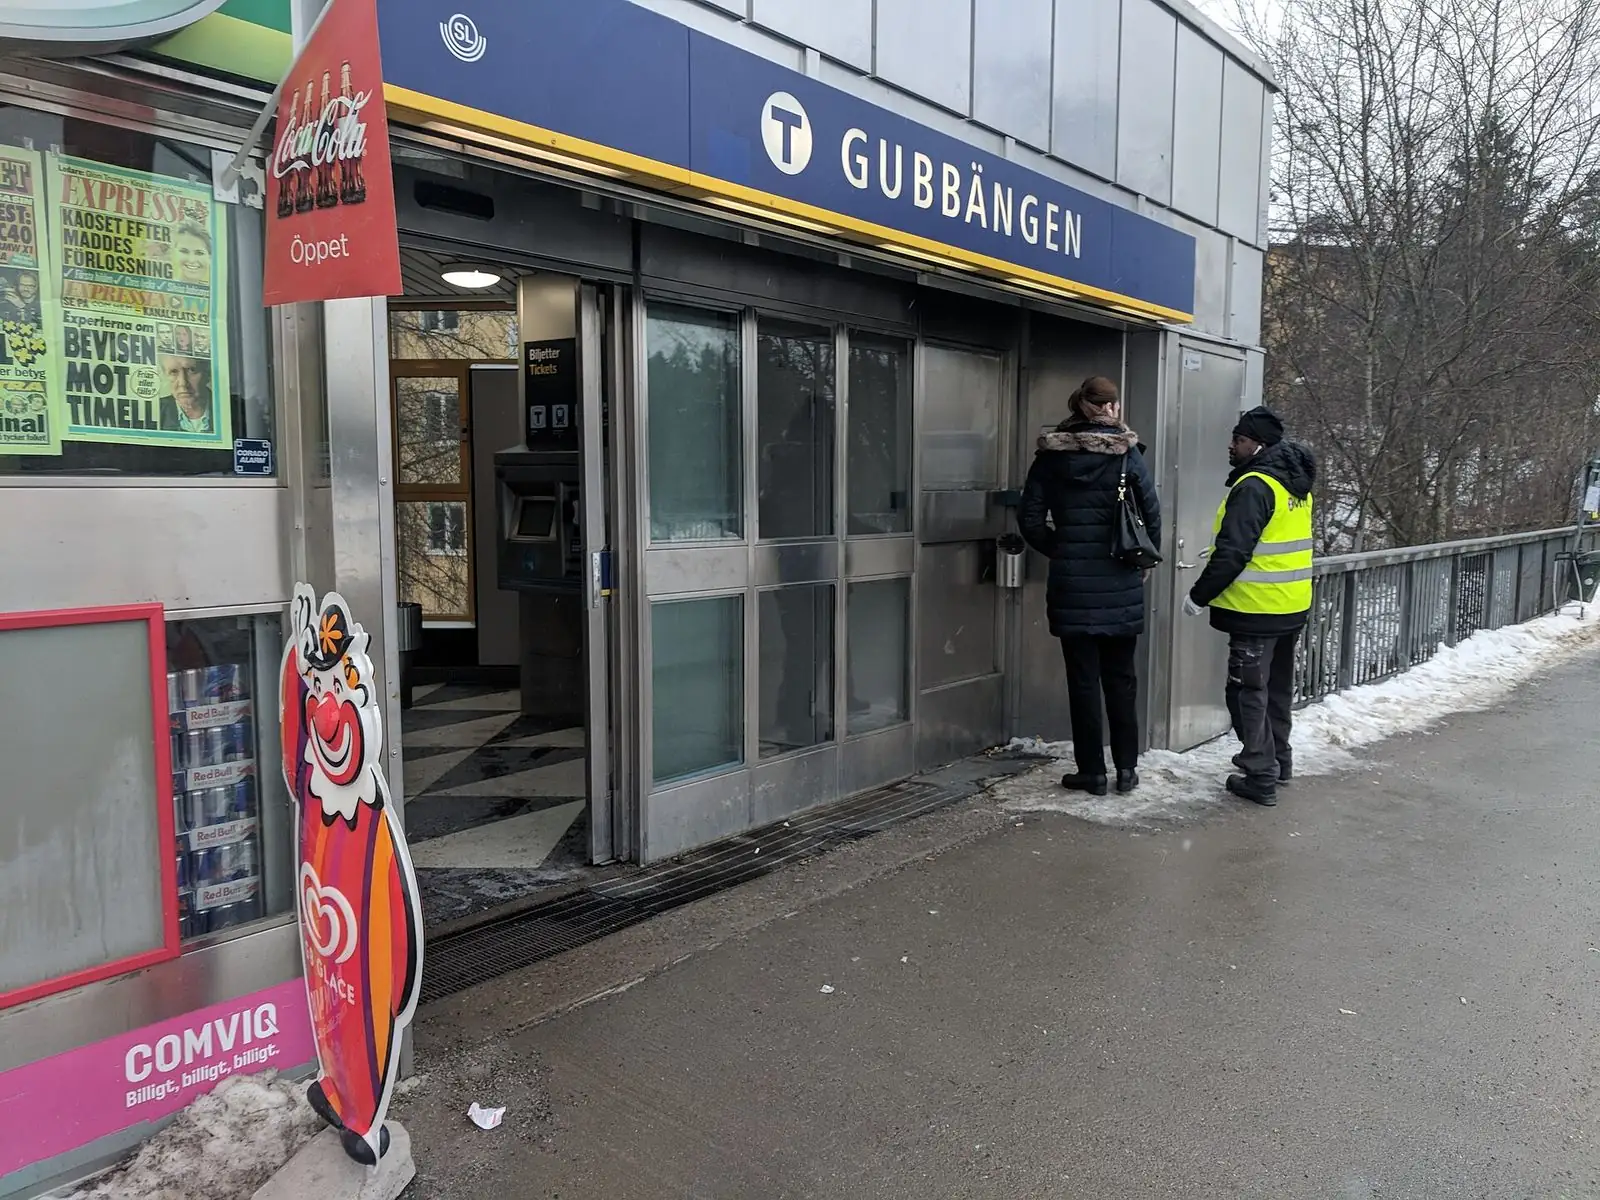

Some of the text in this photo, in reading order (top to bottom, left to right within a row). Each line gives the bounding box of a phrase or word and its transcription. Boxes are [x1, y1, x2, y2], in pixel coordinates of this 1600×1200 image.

[454, 22, 474, 45] SL
[273, 88, 373, 179] Coca-Cola
[841, 128, 1082, 259] GUBBÄNGEN
[62, 207, 171, 243] KAOSET EFTER
[63, 228, 133, 255] MADDES
[291, 233, 350, 266] Öppet
[63, 247, 173, 280] FÖRLOSSNING
[63, 310, 154, 334] Experterna om
[144, 306, 196, 323] KANALPLATS
[64, 326, 156, 366] BEVISEN
[529, 348, 560, 362] Biljetter
[15, 367, 46, 380] betyg
[66, 361, 130, 395] MOT
[529, 364, 558, 375] Tickets
[66, 395, 158, 430] TIMELL
[190, 709, 210, 721] Red
[193, 769, 213, 782] Red
[214, 766, 232, 778] Bull
[197, 828, 216, 841] Red
[203, 887, 222, 901] Red
[317, 957, 355, 1006] GLACE
[125, 1002, 280, 1083] COMVIQ
[125, 1043, 280, 1108] Billigt, billigt, billigt.
